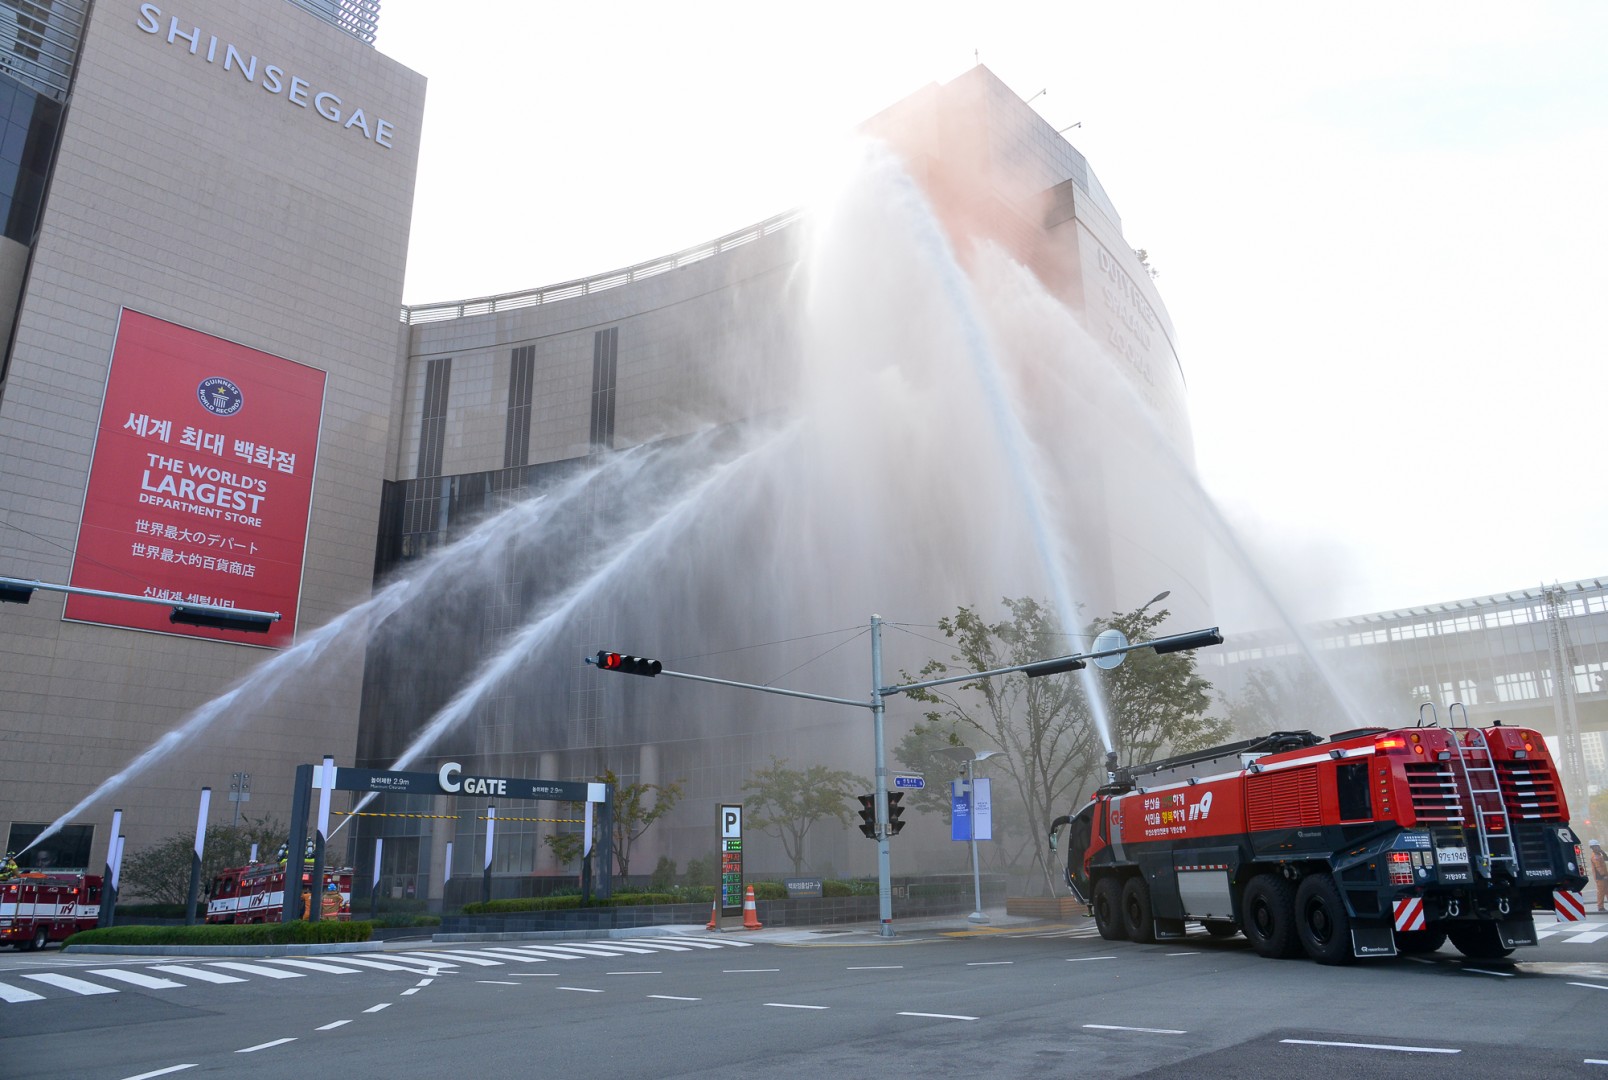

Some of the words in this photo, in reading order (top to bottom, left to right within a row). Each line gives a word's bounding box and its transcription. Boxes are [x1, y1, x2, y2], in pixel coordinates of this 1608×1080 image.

[136, 2, 395, 149] SHINSEGAE
[200, 389, 215, 411] WORLD
[216, 399, 241, 414] RECORDS
[204, 378, 239, 395] GUINNESS
[123, 412, 173, 443] 세계
[179, 426, 225, 457] 최대
[233, 439, 296, 474] 백화점
[147, 453, 185, 474] THE
[188, 463, 267, 493] WORLD'S
[141, 469, 265, 514] LARGEST
[138, 493, 223, 519] DEPARTMENT
[224, 511, 262, 528] STORE
[135, 519, 258, 555] 世界最大のデパート
[131, 542, 256, 578] 世界最大的百貨商店
[393, 777, 410, 786] 2.9m
[438, 762, 462, 793] C
[464, 778, 507, 795] GATE
[1144, 797, 1160, 810] 부산을
[1144, 812, 1160, 825] 시민을
[1162, 809, 1185, 824] 행복하게
[1188, 791, 1213, 821] 119
[725, 812, 737, 833] P
[60, 900, 75, 914] 119
[251, 890, 265, 907] 119
